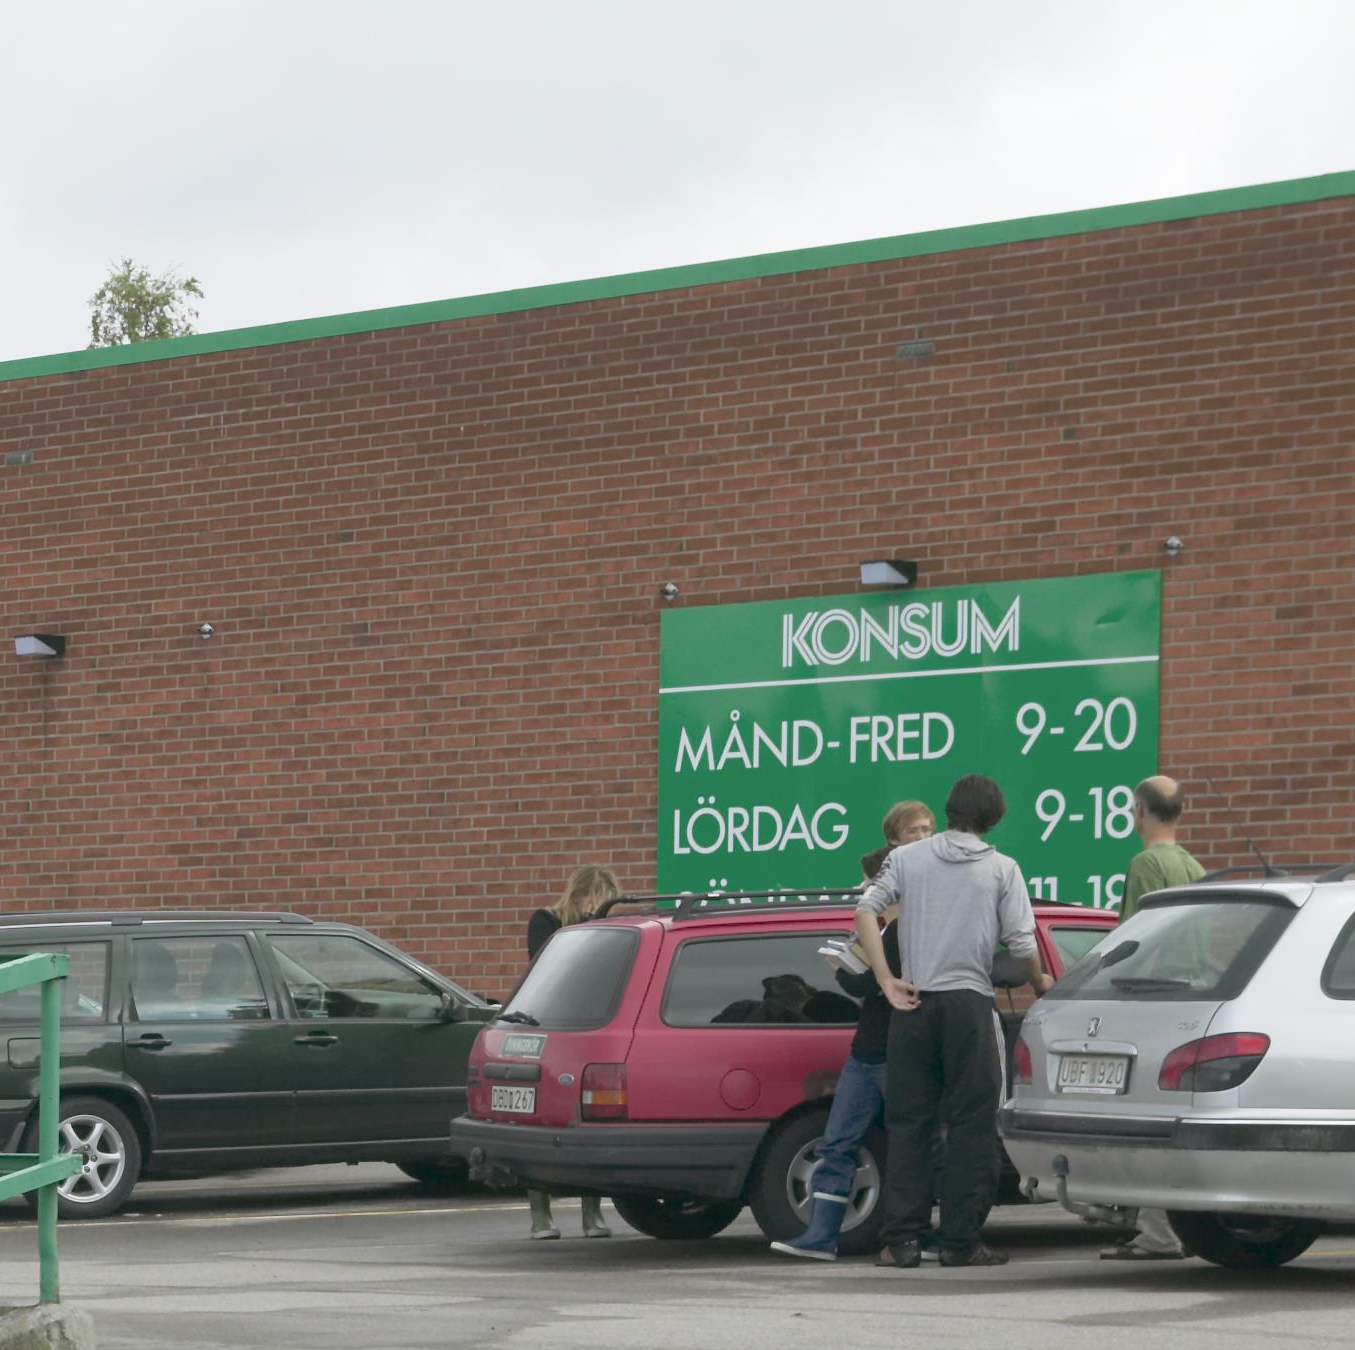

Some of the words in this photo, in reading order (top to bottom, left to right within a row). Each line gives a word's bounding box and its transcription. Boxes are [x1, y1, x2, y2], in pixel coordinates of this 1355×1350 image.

[782, 596, 1021, 668] KONSUM
[1015, 696, 1137, 756] 9-20
[674, 796, 850, 855] LÖRDAG
[1035, 785, 1135, 842] 9-18
[514, 1090, 535, 1110] 267
[1061, 1060, 1088, 1083] UBF
[1098, 1062, 1124, 1084] 920
